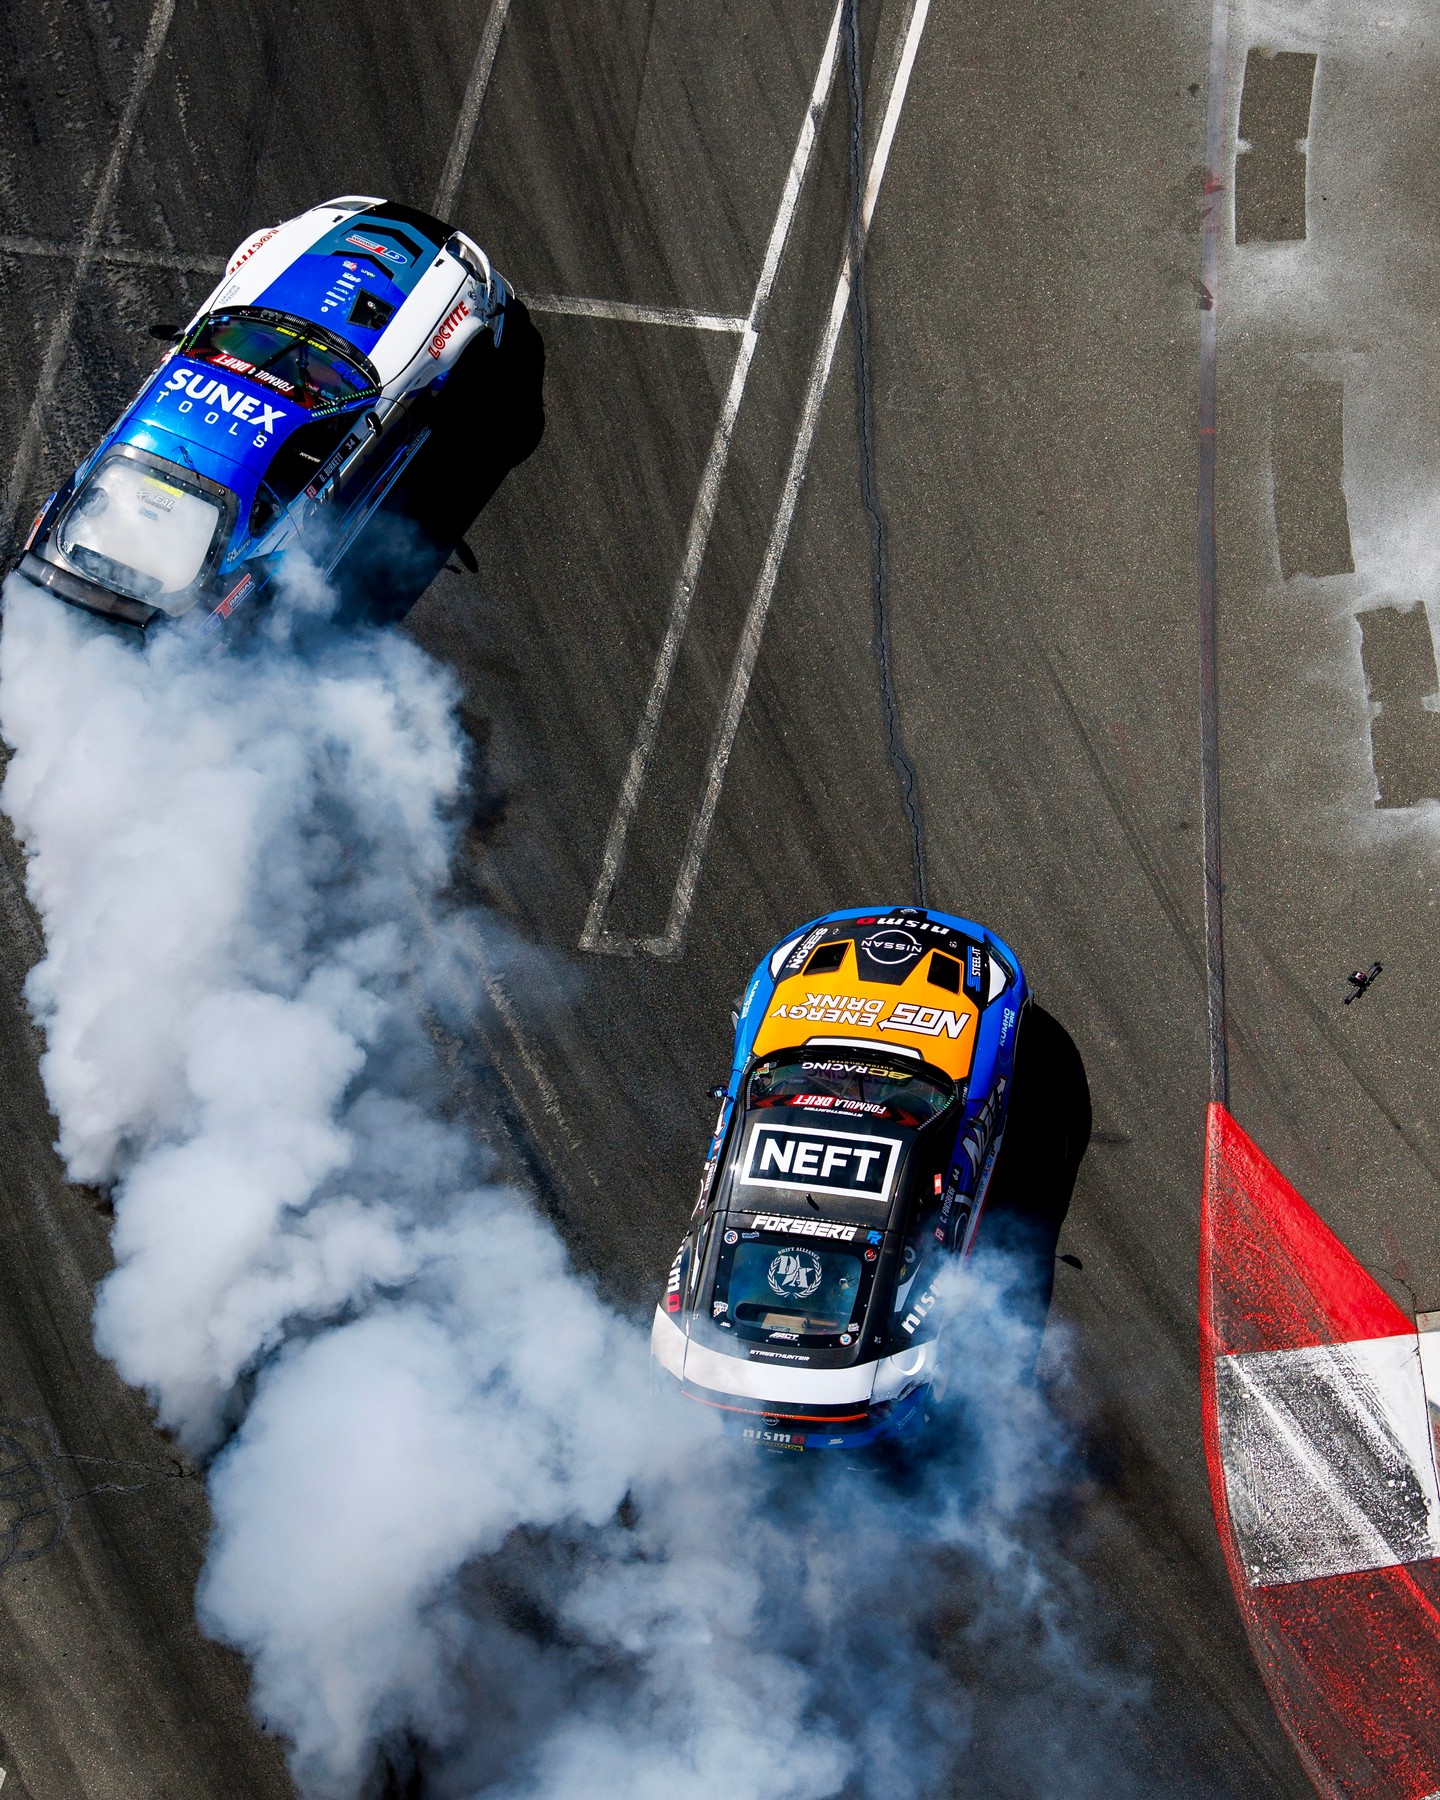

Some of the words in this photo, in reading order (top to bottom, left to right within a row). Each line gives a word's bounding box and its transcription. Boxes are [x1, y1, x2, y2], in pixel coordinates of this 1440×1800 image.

[427, 300, 470, 361] LOCTITE
[213, 353, 252, 372] DRIFT
[164, 368, 287, 435] SUNEX
[156, 389, 268, 449] TOOLS
[323, 452, 344, 478] BURKETT
[345, 438, 357, 451] 34
[149, 491, 175, 510] FEAL
[228, 580, 255, 607] RADIAL
[856, 917, 950, 936] nismo
[790, 926, 828, 970] SEBON
[861, 939, 922, 954] NISSAN
[971, 946, 982, 979] STEEL-IT
[770, 1002, 880, 1028] ENERGY
[805, 992, 886, 1014] DRINK
[878, 1002, 972, 1040] NOS
[999, 1007, 1011, 1047] KUMHO
[1008, 1010, 1016, 1028] TIRE
[802, 1061, 869, 1074] RACING
[865, 1062, 894, 1070] CUSTOM
[793, 1094, 837, 1107] DRIFT
[834, 1098, 887, 1115] FORMULA
[759, 1138, 881, 1182] NEFT
[943, 1185, 956, 1217] FORSBERG
[952, 1168, 960, 1181] 64
[750, 1214, 858, 1241] FORSBERG
[777, 1247, 795, 1255] DRIFT
[795, 1246, 821, 1260] ALLIANCE
[749, 1349, 810, 1362] STREETHUNTER
[742, 1428, 805, 1445] nismo
